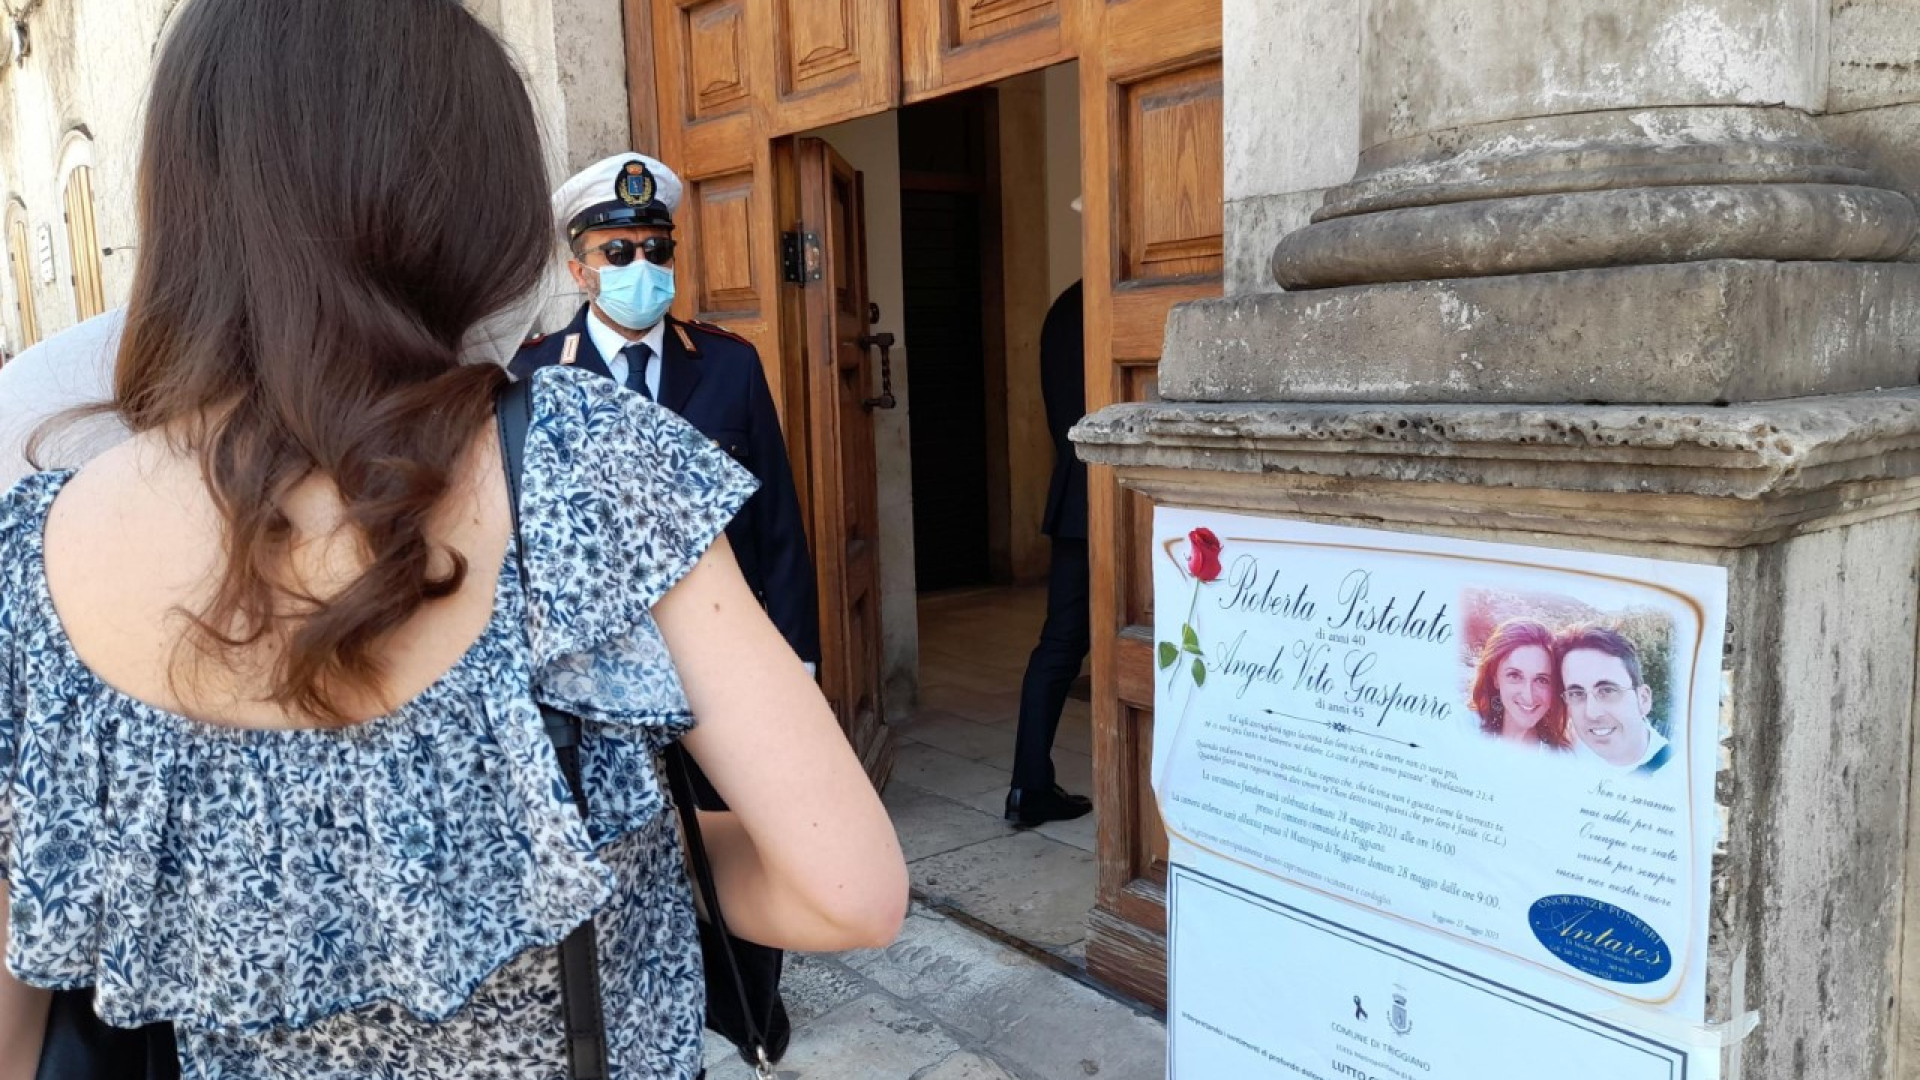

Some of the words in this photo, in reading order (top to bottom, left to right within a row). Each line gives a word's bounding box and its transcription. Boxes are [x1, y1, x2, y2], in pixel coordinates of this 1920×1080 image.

[1220, 554, 1317, 622] Roberta
[1328, 569, 1453, 644] Pistolato
[1316, 629, 1324, 640] di
[1326, 632, 1348, 644] anni
[1352, 634, 1365, 646] 40
[1207, 630, 1283, 699] Angelo
[1294, 640, 1334, 696] Vito
[1344, 650, 1452, 726] Gasparro
[1316, 698, 1324, 710] di
[1327, 702, 1350, 714] anni
[1352, 706, 1364, 718] 45
[1349, 818, 1375, 833] maggio
[1376, 821, 1397, 838] 2021
[1400, 831, 1414, 843] alle
[1630, 818, 1653, 832] per
[1612, 860, 1633, 874] per
[1409, 873, 1437, 890] maggio
[1439, 880, 1460, 896] dalle
[1462, 891, 1474, 901] ore
[1538, 896, 1604, 910] ONORANZE
[1609, 906, 1661, 944] FUNEBRI
[1534, 910, 1663, 964] Antares
[1331, 1022, 1368, 1044] COMUNE
[1370, 1038, 1380, 1049] DI
[1382, 1042, 1430, 1071] TRIGGIANO
[1332, 1059, 1366, 1080] LUTTO
